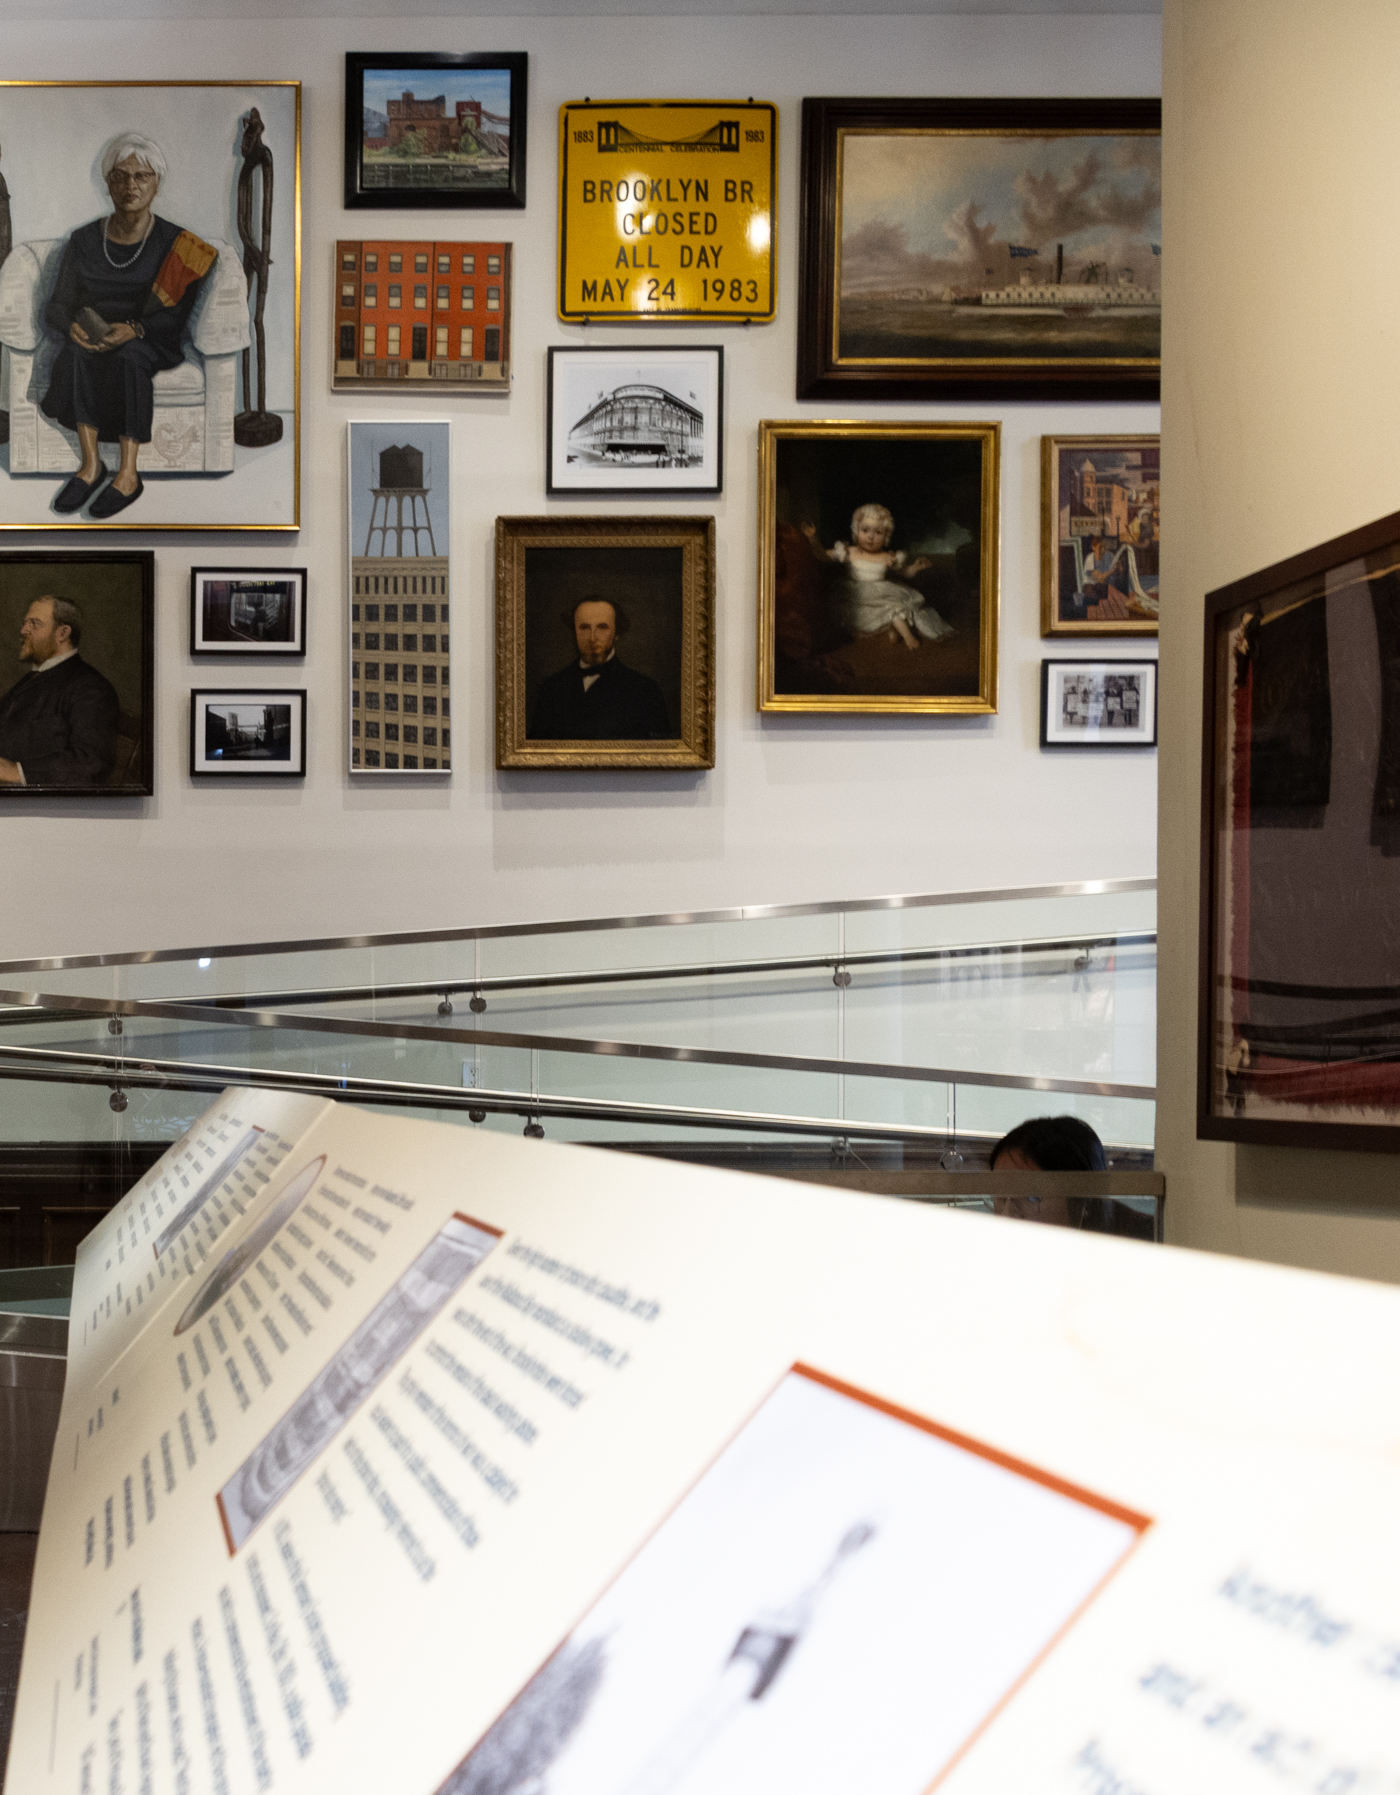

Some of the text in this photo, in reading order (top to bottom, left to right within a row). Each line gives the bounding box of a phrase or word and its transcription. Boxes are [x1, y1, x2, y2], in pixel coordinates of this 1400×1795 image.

[573, 130, 594, 144] 1883
[744, 129, 765, 143] 1983
[618, 145, 720, 153] CENTENNIAL CELEBRATION
[583, 179, 754, 203] BROOKLYN BR
[622, 212, 718, 236] CLOSED
[615, 245, 723, 269] ALL DAY
[581, 278, 759, 303] MAY 24 1983
